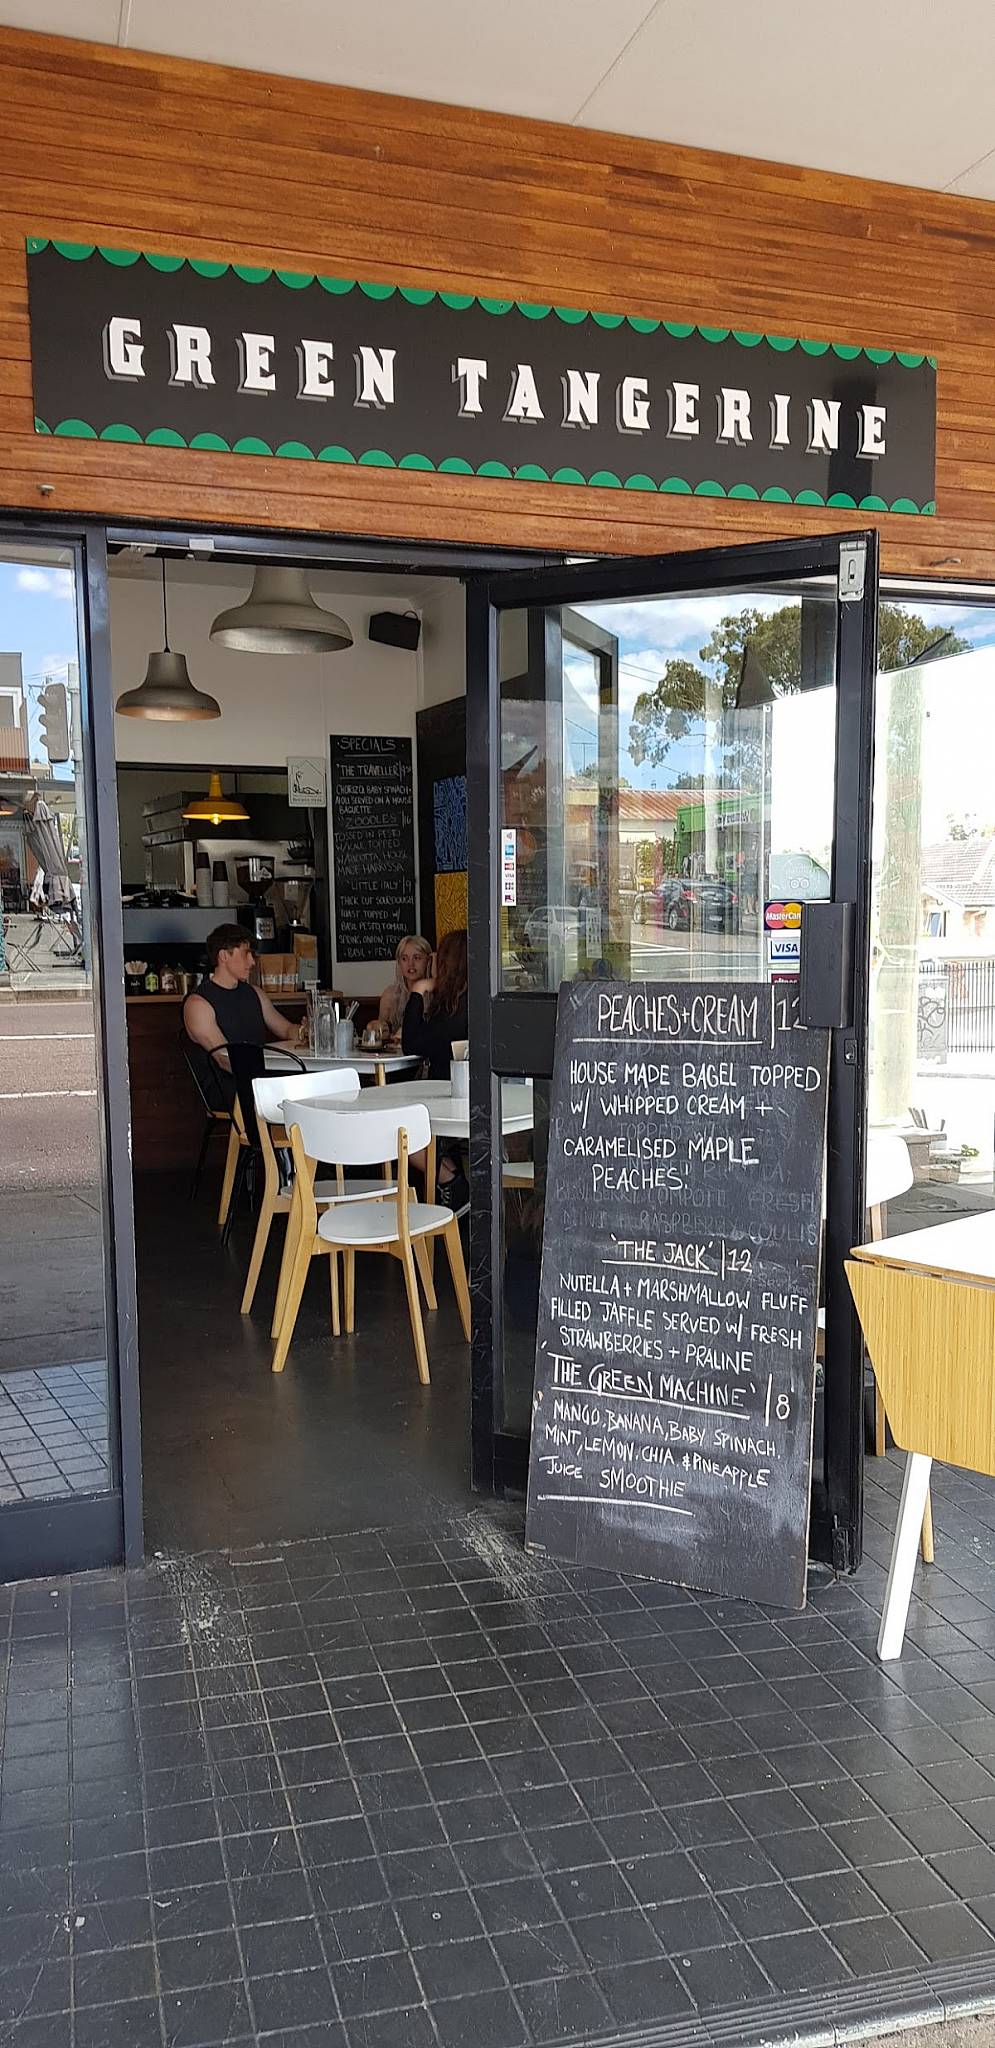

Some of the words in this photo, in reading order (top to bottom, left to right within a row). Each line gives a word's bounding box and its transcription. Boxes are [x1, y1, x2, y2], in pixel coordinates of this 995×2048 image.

[103, 316, 397, 409] GREEN
[451, 357, 888, 460] TANGERINE
[339, 737, 396, 752] SPECIALS
[775, 943, 798, 953] VISA
[570, 1060, 617, 1085] HOUSE
[624, 1062, 670, 1089] MADE
[683, 1062, 736, 1090] BAGEL
[750, 1064, 820, 1091] TOPPED
[599, 1095, 679, 1117] WHIPPED
[687, 1093, 745, 1120] CREAM
[563, 1136, 676, 1159] CARAMELISED
[688, 1136, 759, 1165] MAPLE
[560, 1273, 620, 1299] NUTELLA
[637, 1278, 750, 1309] MARSHMALLOW
[761, 1292, 808, 1315] FLUFF
[551, 1297, 591, 1321] FILLED
[599, 1301, 655, 1330] JAFFLE
[662, 1312, 720, 1334] SERVED
[750, 1324, 802, 1350] FRESH
[559, 1325, 662, 1359] STRAWBERRIES
[685, 1343, 753, 1375] PRALINE
[588, 1363, 653, 1399] GREEN
[667, 1420, 706, 1445] BABY
[539, 1455, 583, 1479] JUICE
[599, 1466, 687, 1498] SMOOTHIE
